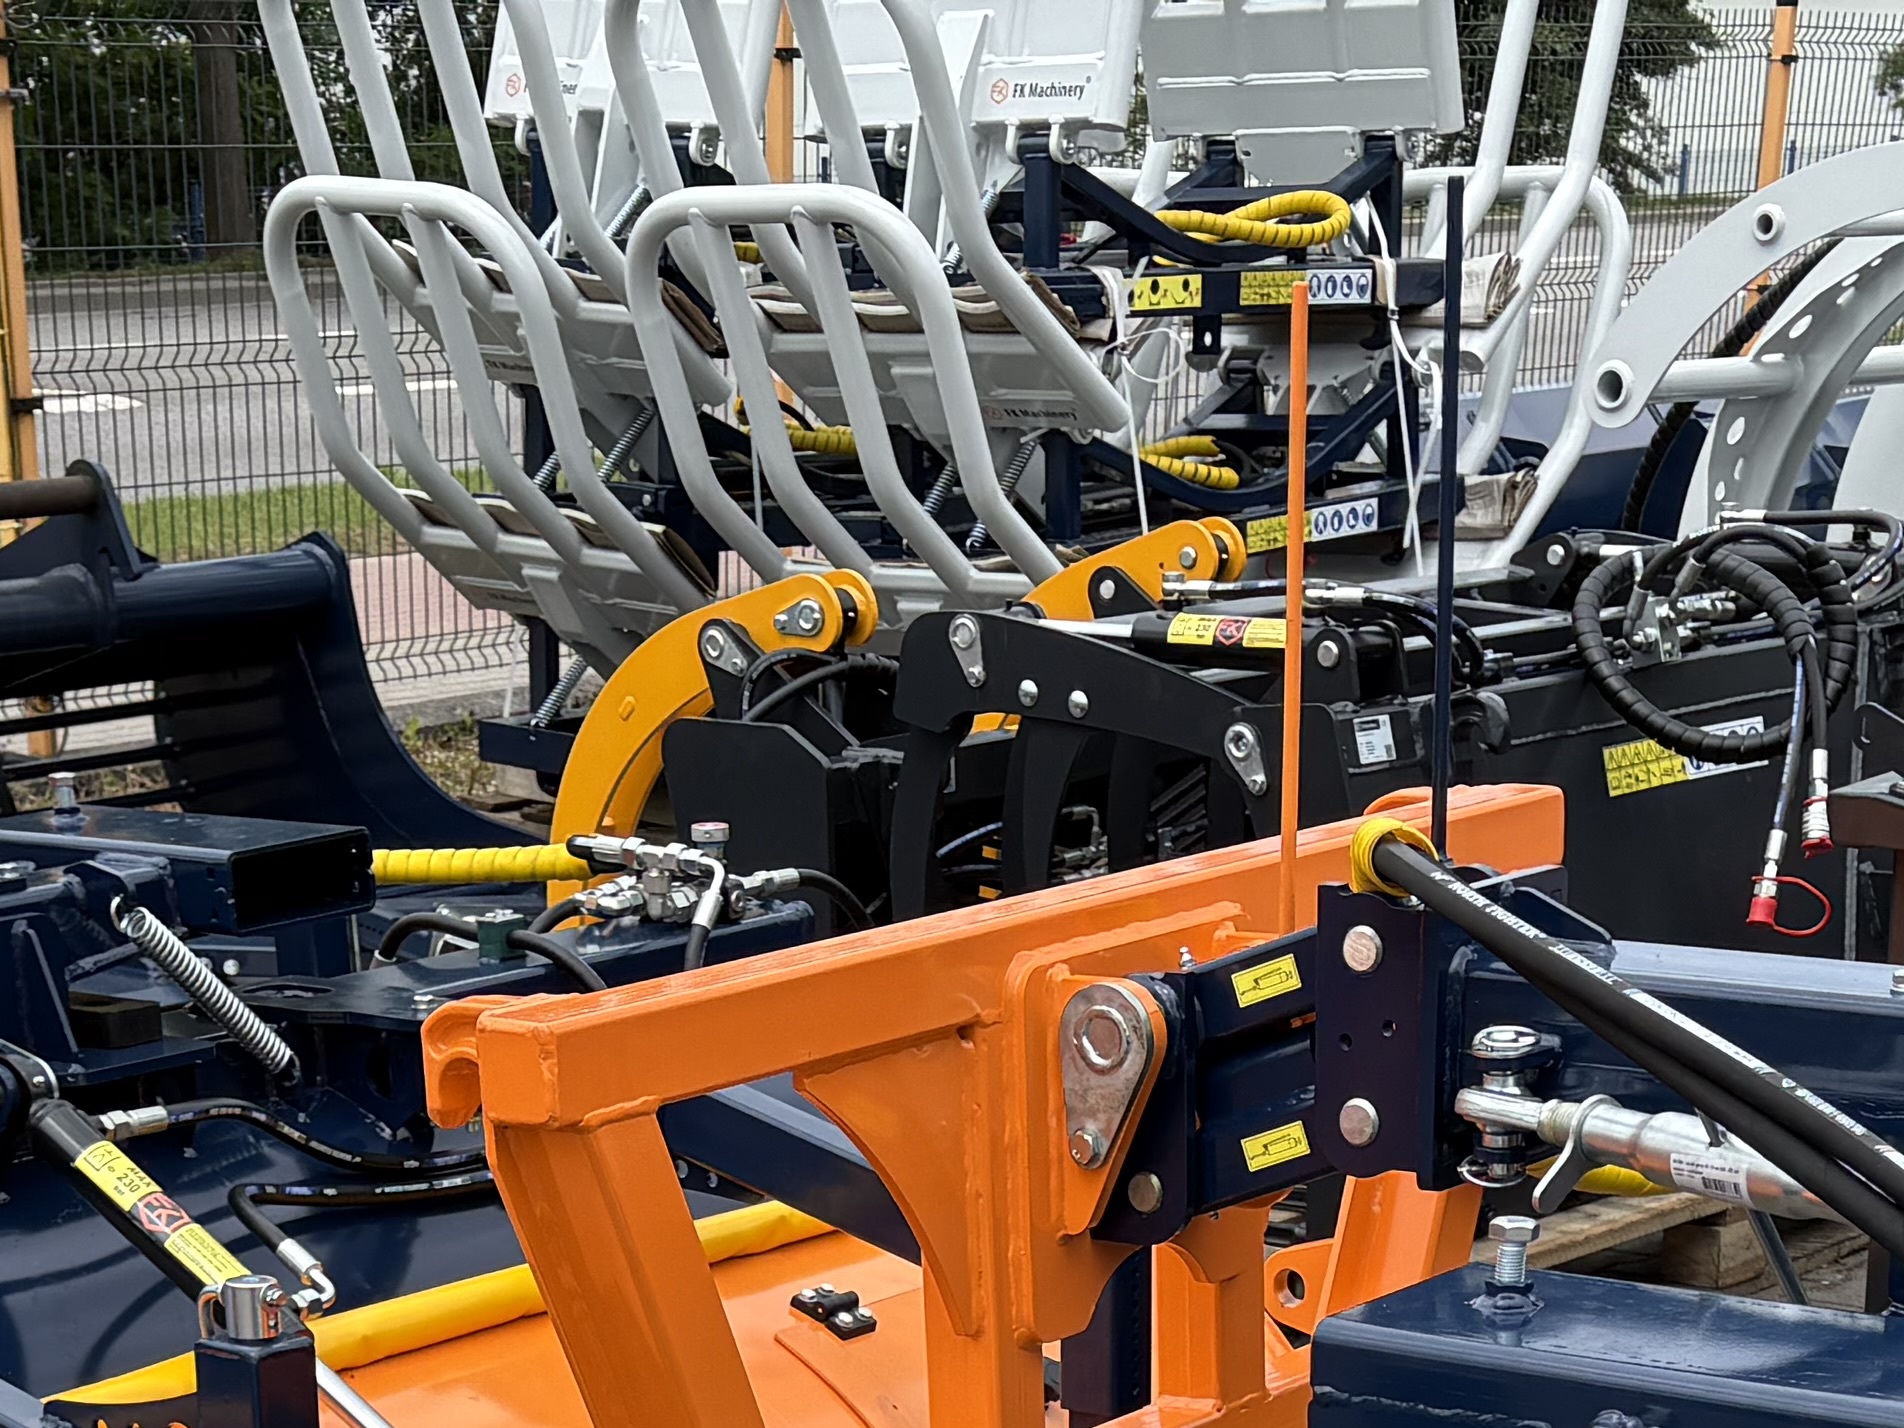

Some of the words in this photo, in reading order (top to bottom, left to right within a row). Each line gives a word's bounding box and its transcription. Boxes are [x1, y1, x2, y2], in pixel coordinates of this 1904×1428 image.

[1012, 82, 1027, 98] FK
[1028, 81, 1086, 101] Machinery
[116, 1172, 141, 1194] 230
